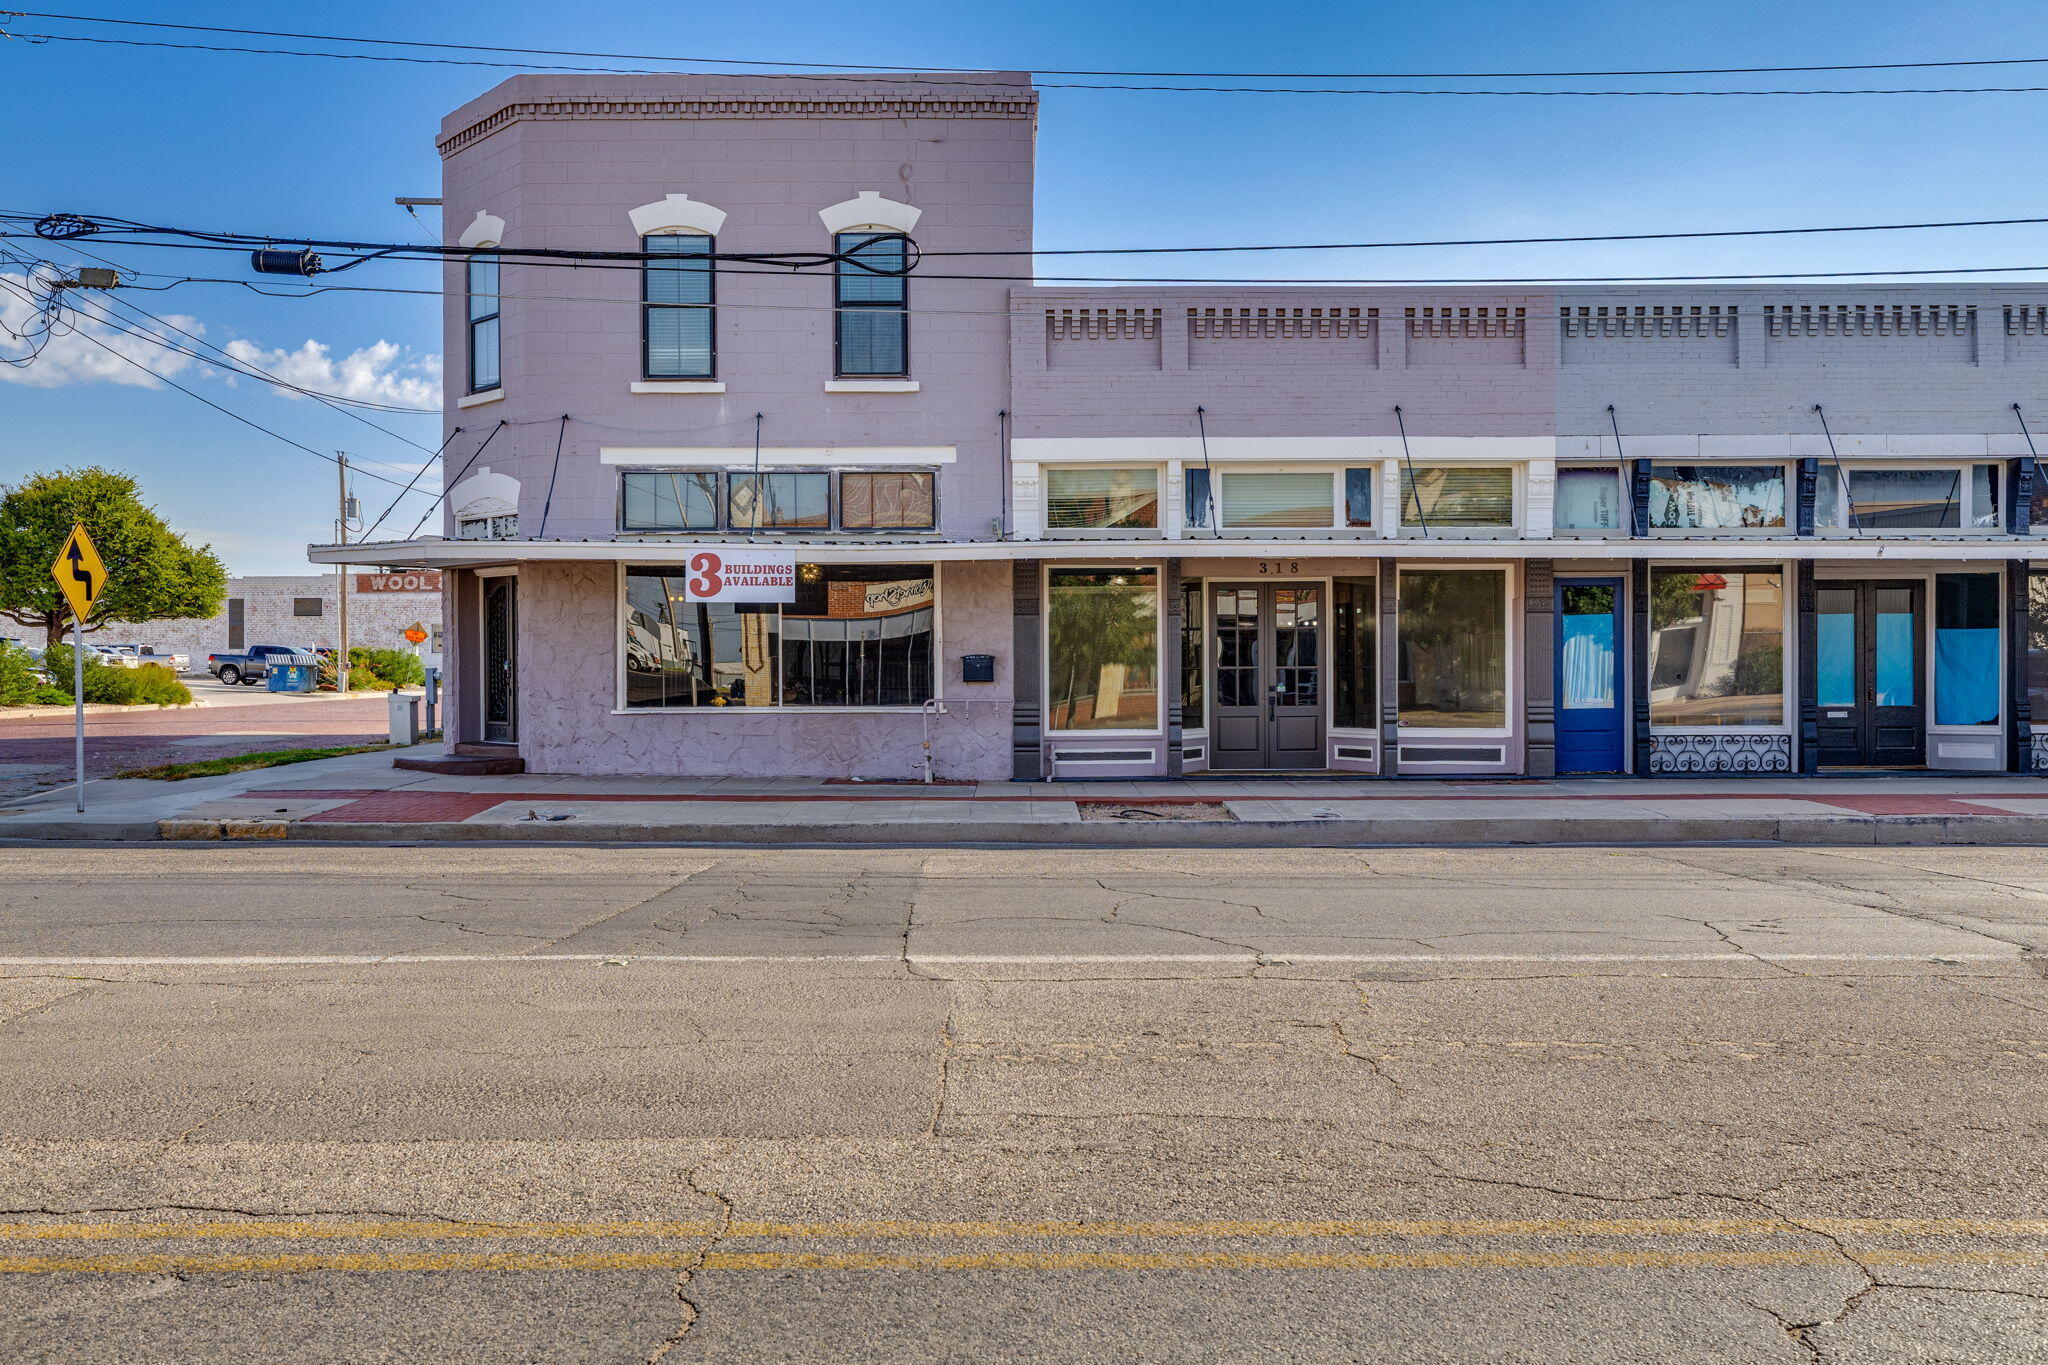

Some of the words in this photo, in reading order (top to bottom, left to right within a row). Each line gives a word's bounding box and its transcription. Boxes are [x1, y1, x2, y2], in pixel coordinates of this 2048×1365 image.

[724, 564, 793, 575] BUILDINGS
[1259, 562, 1299, 574] 318
[689, 552, 723, 598] 3
[370, 575, 433, 591] WOOL
[723, 576, 794, 587] AVAILABLE
